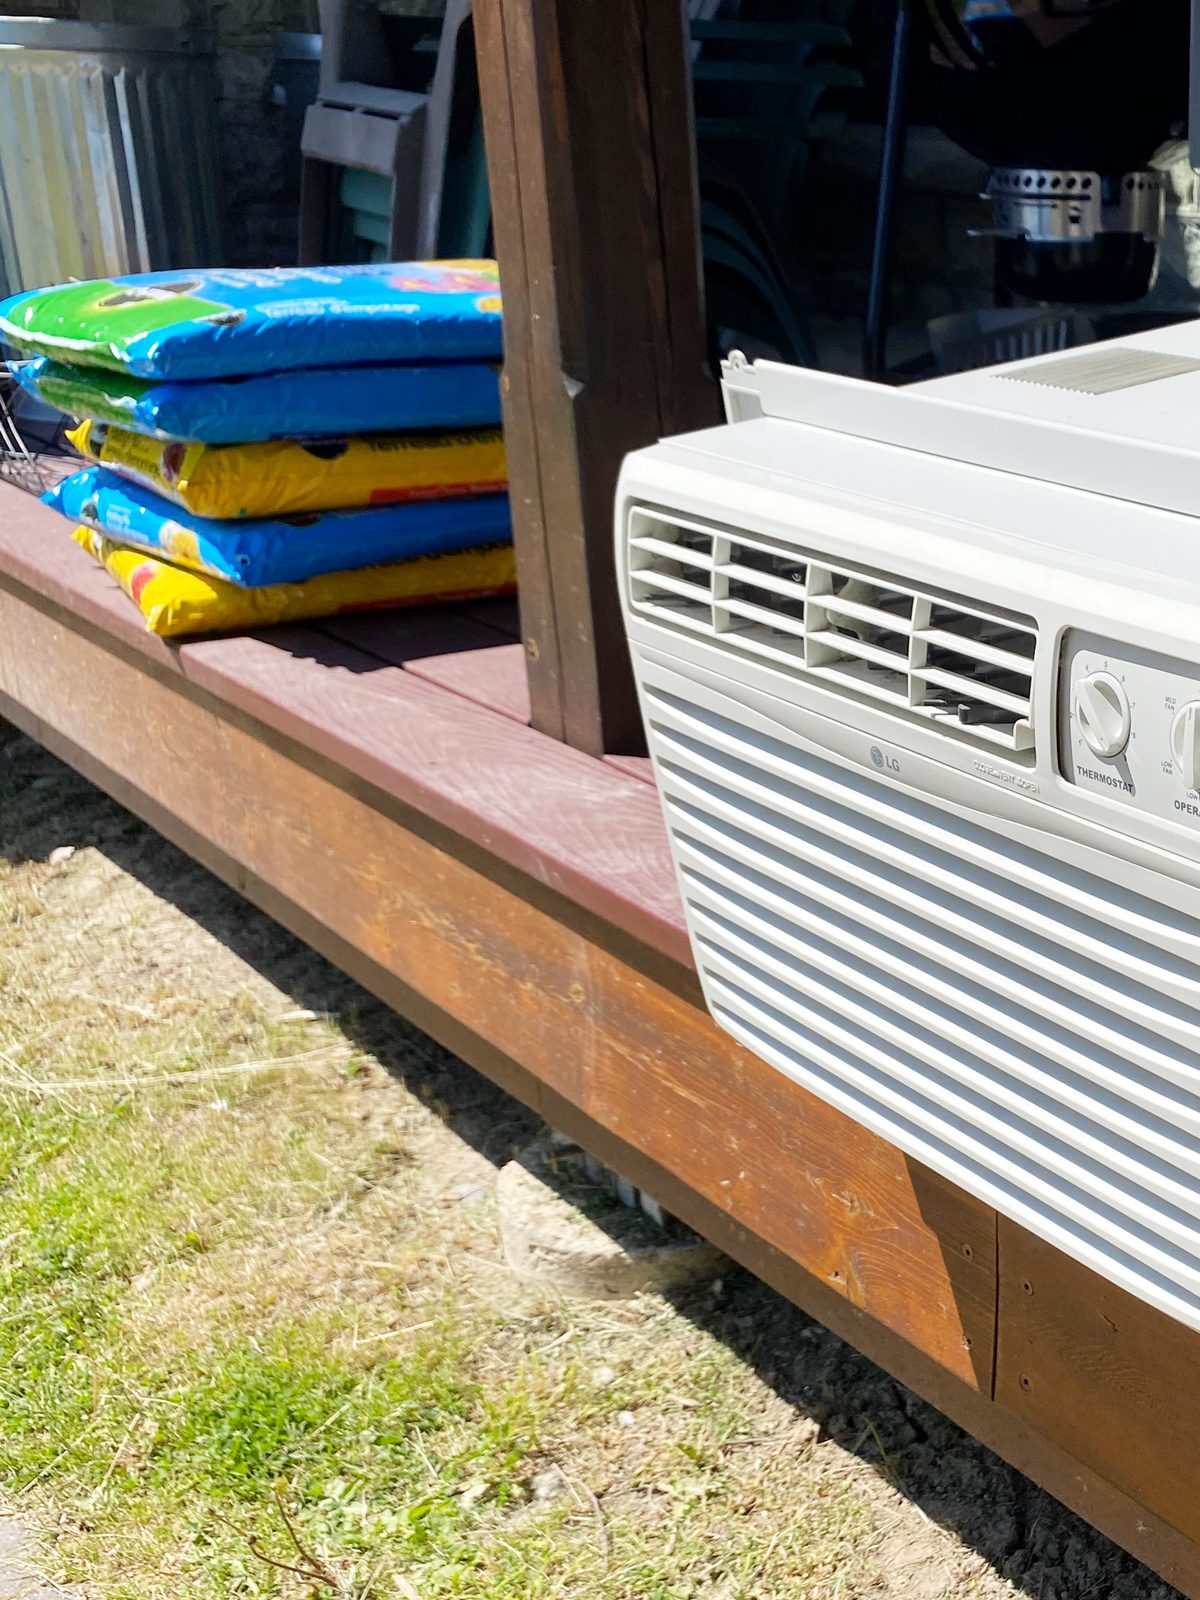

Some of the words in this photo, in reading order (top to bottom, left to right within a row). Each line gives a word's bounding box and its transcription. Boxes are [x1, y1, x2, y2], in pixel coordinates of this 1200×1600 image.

[886, 755, 900, 772] LG
[1077, 766, 1134, 793] THERMOSTAT
[1186, 792, 1198, 801] LOW
